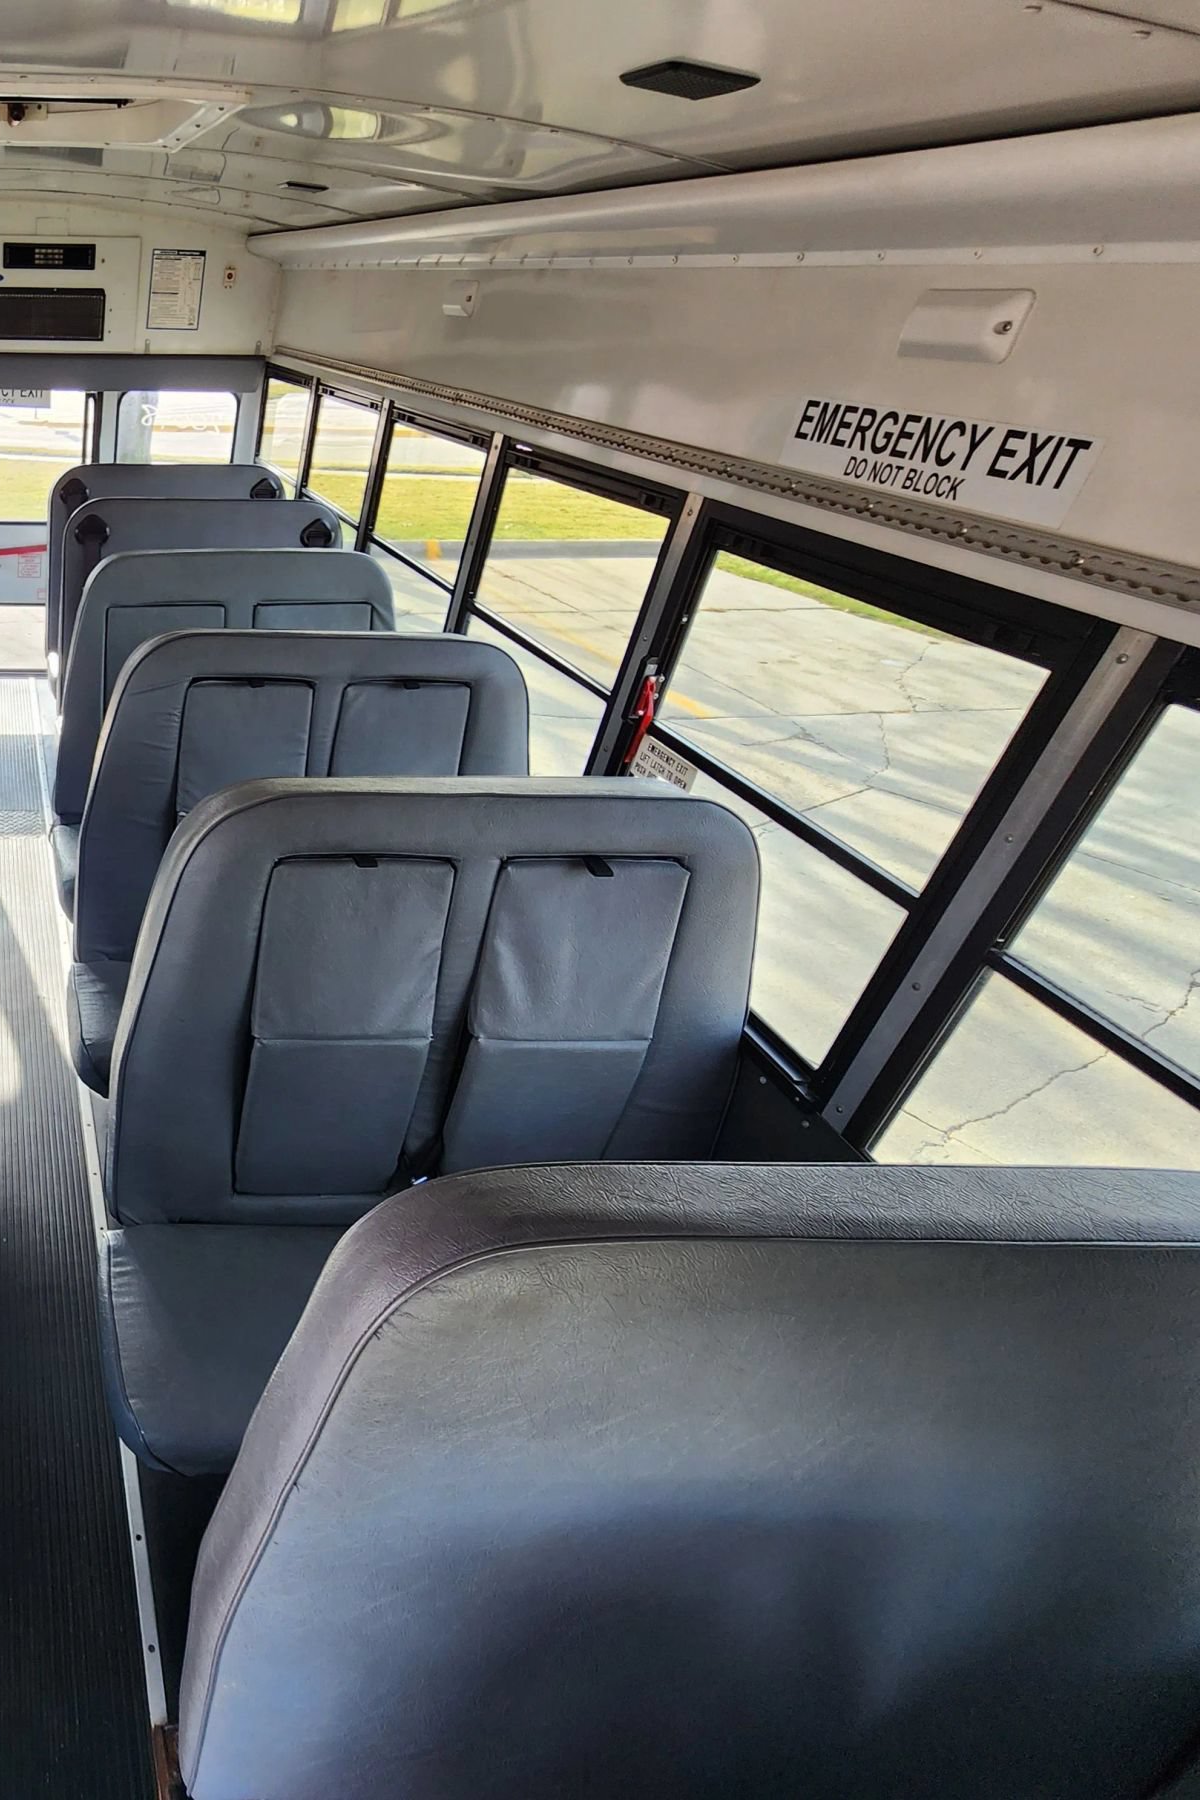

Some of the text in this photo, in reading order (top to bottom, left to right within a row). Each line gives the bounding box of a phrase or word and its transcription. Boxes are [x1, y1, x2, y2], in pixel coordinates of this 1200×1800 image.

[794, 400, 1093, 490] EMERGENCY EXIT
[843, 456, 966, 501] DO NOT BLOCK
[647, 743, 689, 776] EMERGENCY EXIT
